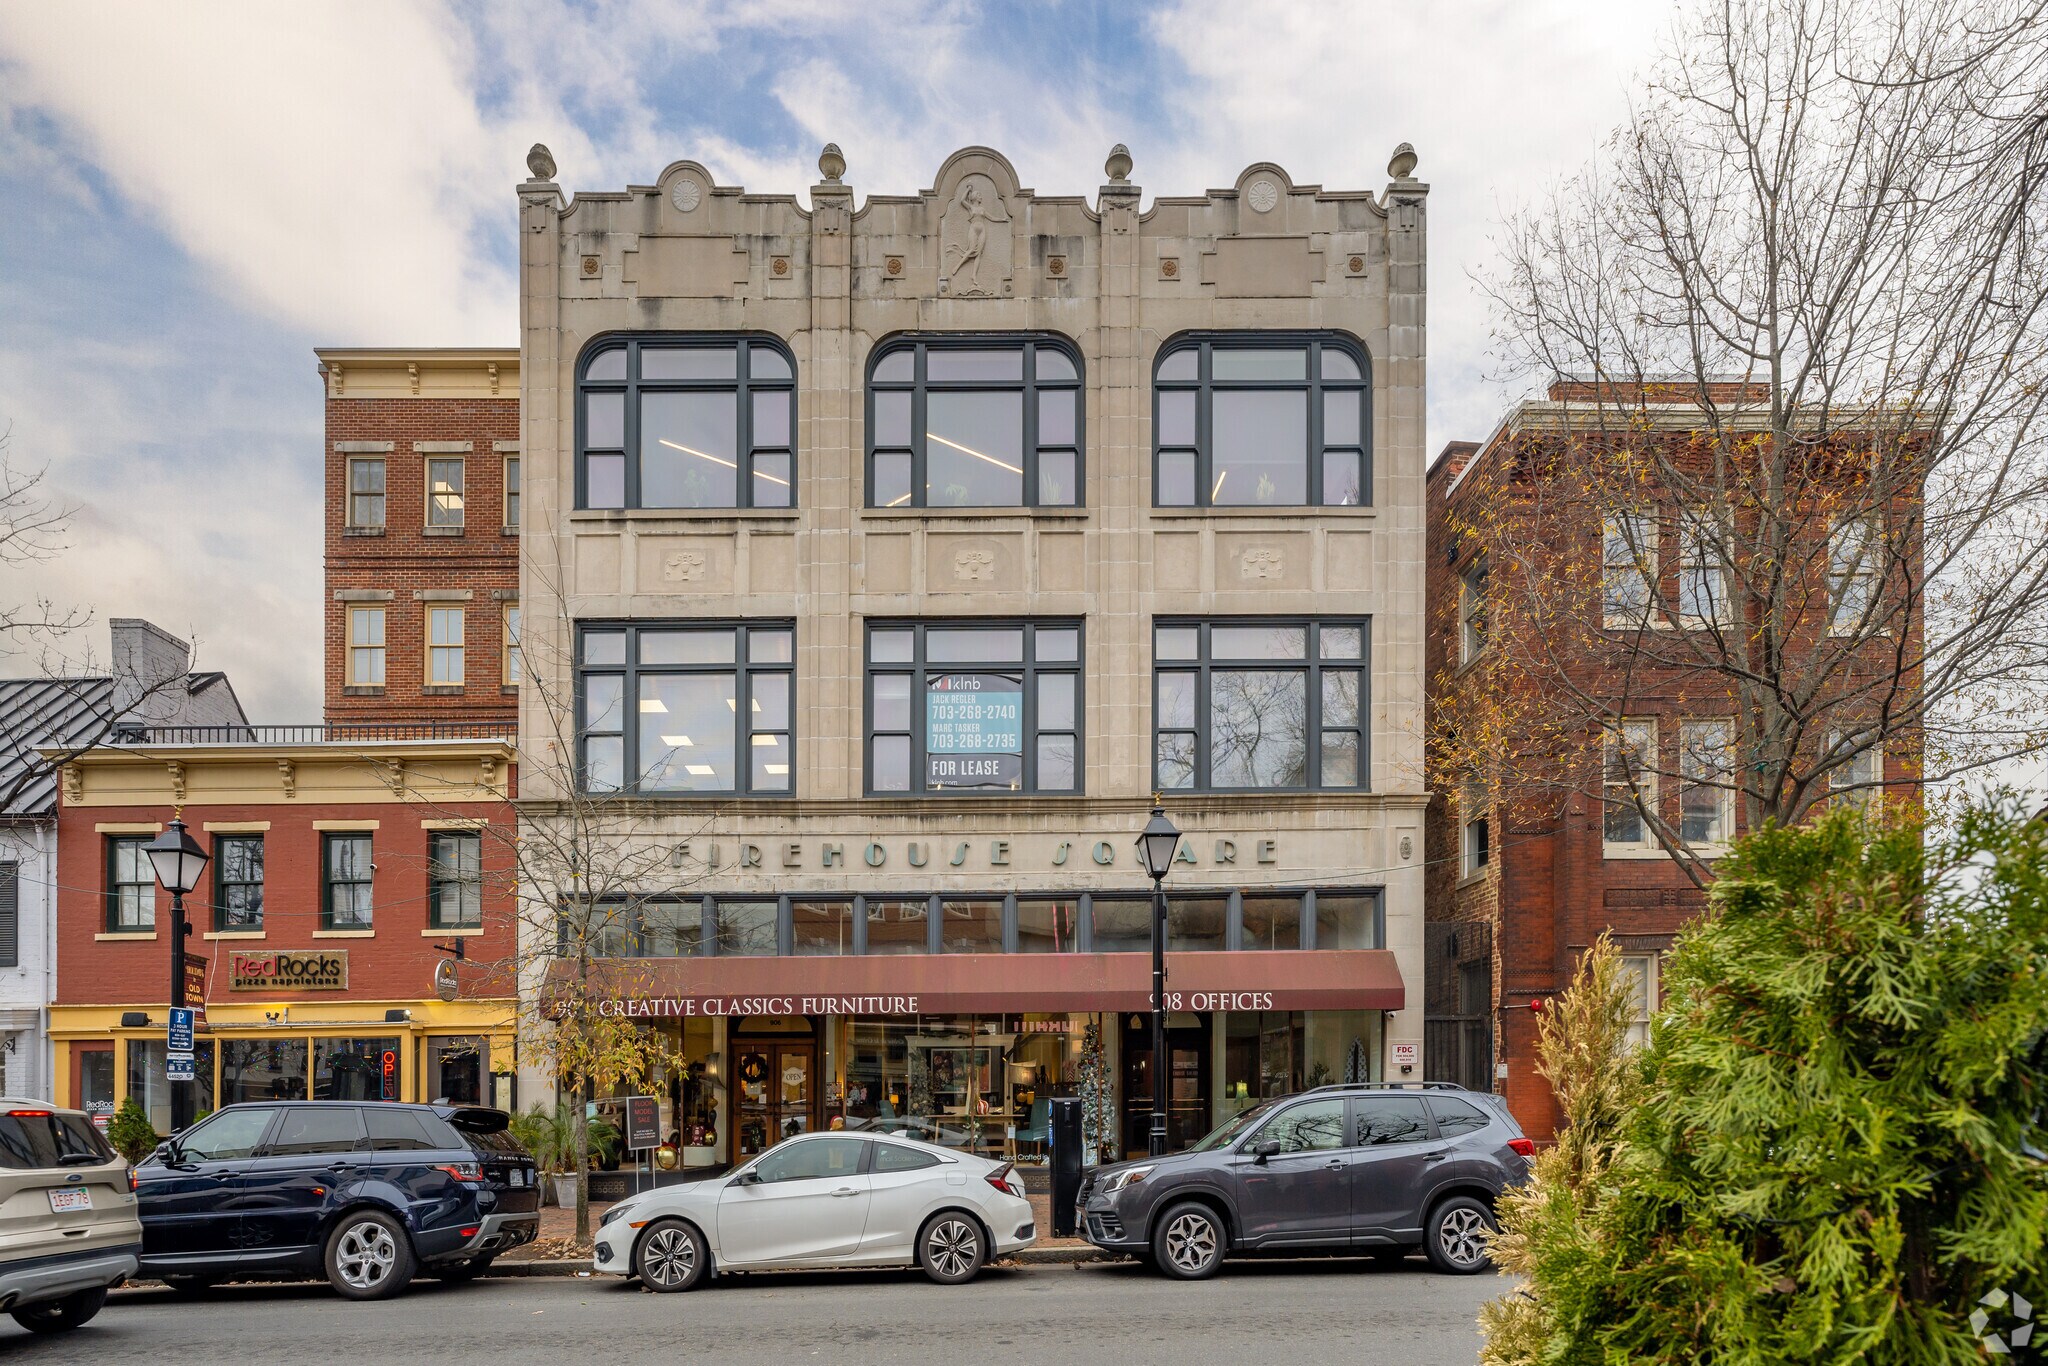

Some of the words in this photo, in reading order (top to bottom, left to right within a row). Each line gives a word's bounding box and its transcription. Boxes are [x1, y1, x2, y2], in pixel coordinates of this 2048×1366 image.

[953, 676, 981, 690] klnb
[932, 695, 949, 704] JACK
[951, 695, 976, 704] REGLER
[932, 705, 1016, 719] 703-268-2740
[932, 723, 953, 733] MARC
[955, 723, 980, 733] TASKER
[932, 733, 1016, 748] 703-268-2735
[932, 761, 956, 776] FOR
[961, 760, 1000, 776] LEASE
[671, 840, 1010, 868] FIREHOUSE
[1052, 838, 1276, 864] SQARE
[233, 954, 340, 977] RedRocks
[188, 984, 201, 993] OLD
[235, 976, 267, 987] pizza
[271, 976, 339, 986] napoletana
[185, 992, 204, 1003] TOWN
[1191, 993, 1273, 1010] OFFICES
[600, 999, 695, 1017] CREATIVE
[702, 997, 793, 1016] CLASSICS
[801, 996, 918, 1014] FURNITURE
[383, 1051, 395, 1097] OPEN
[785, 1073, 801, 1081] OPEN
[1018, 1153, 1042, 1161] Crafted
